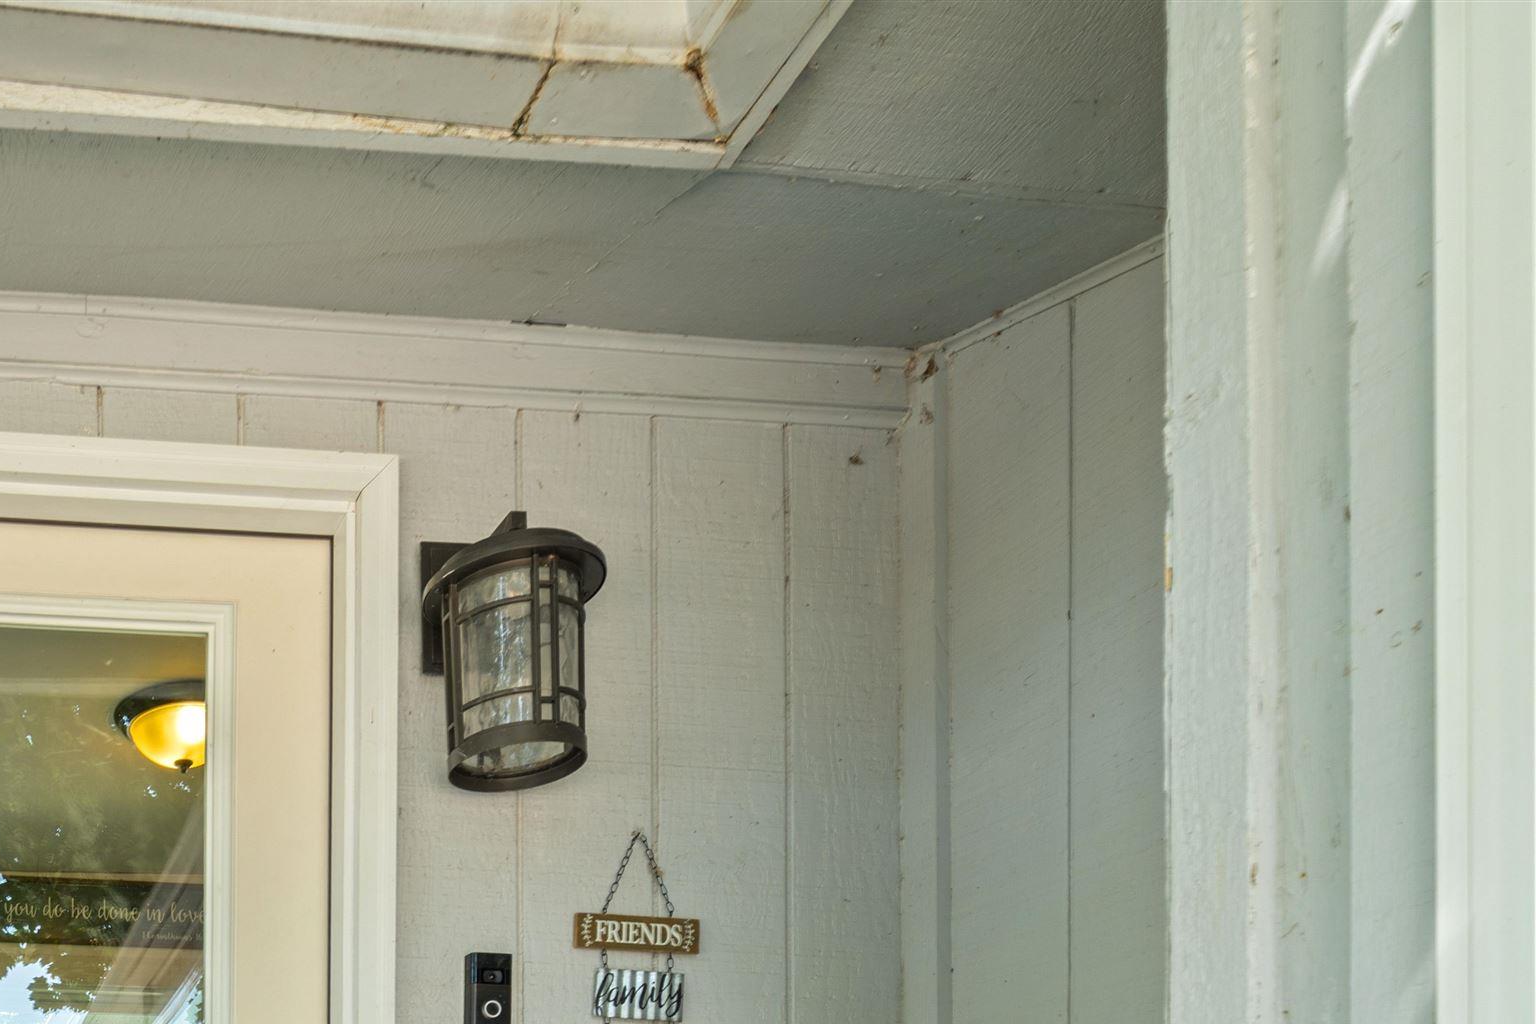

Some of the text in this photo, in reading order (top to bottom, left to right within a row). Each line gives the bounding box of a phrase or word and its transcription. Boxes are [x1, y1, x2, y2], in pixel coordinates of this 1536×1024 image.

[4, 901, 38, 923] you
[42, 897, 66, 919] do
[70, 897, 92, 920] be
[97, 898, 141, 922] done
[146, 903, 166, 923] in
[595, 919, 683, 947] FRIENDS
[595, 973, 683, 1018] family
